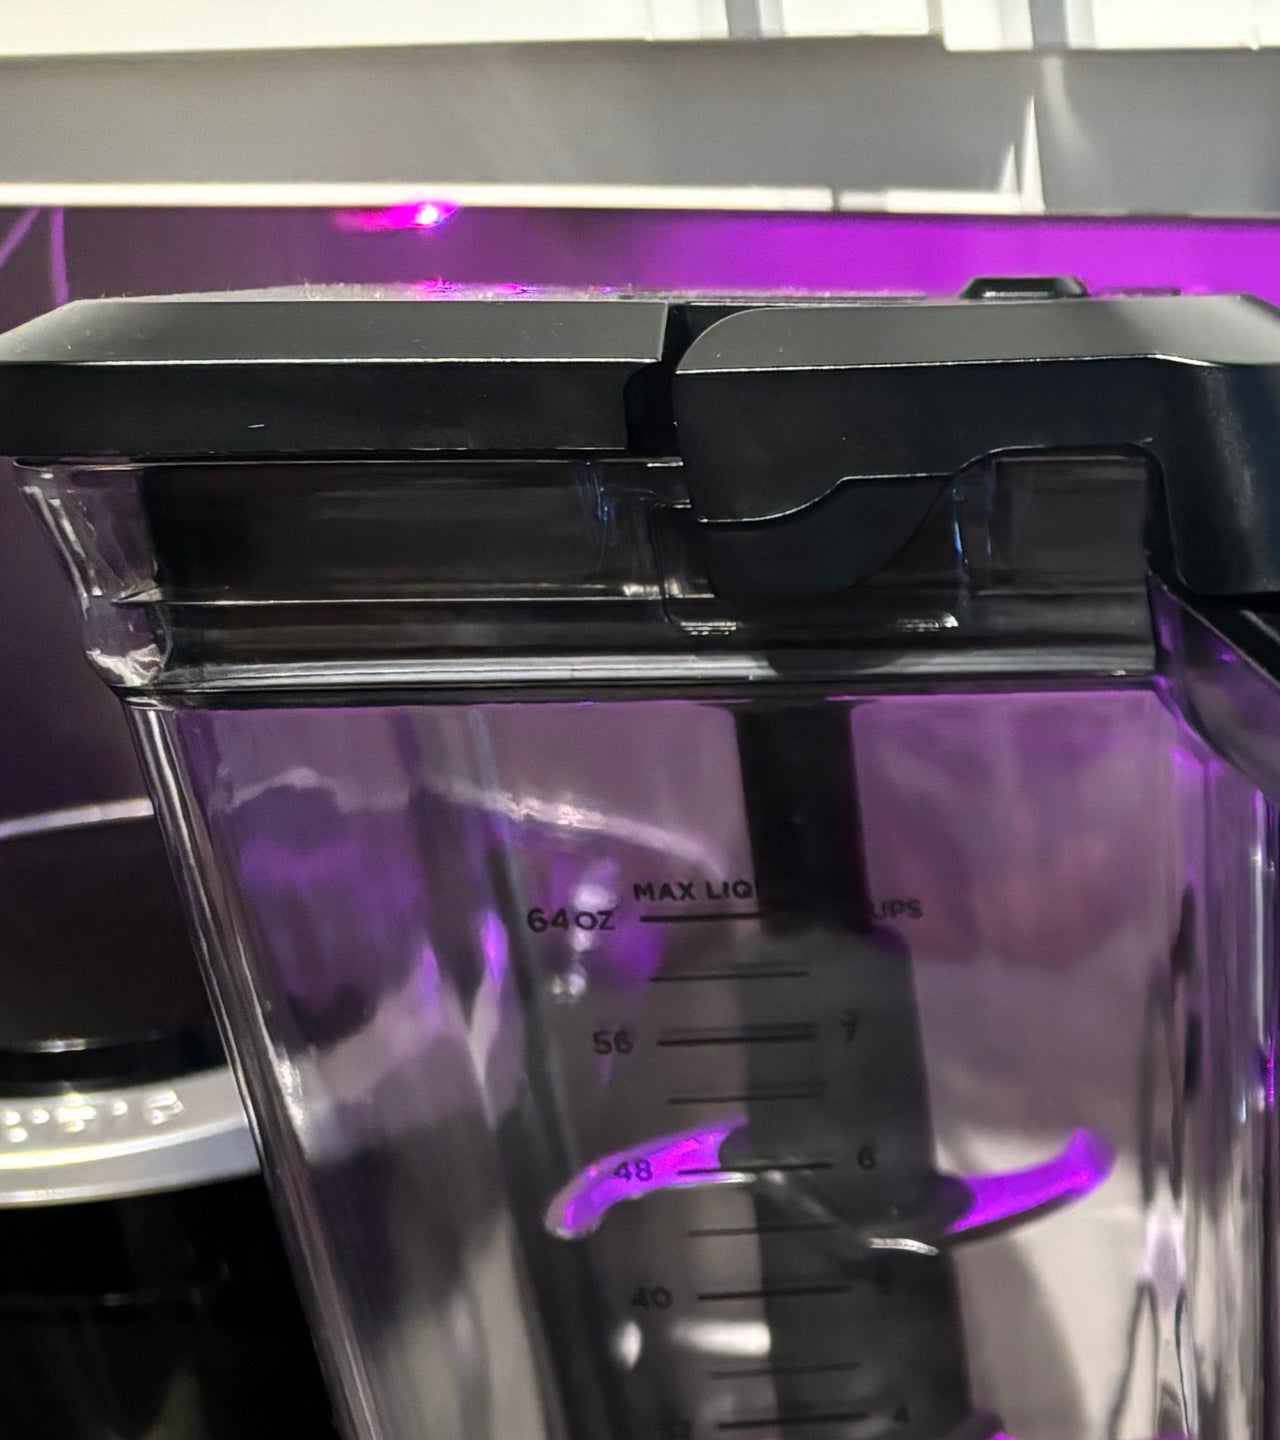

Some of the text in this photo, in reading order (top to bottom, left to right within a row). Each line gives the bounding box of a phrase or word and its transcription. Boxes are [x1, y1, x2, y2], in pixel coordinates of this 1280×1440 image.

[633, 879, 754, 901] MAX LIQ
[592, 1028, 634, 1055] 56
[612, 1157, 653, 1183] 48
[857, 1147, 877, 1171] 6
[631, 1285, 673, 1310] 40
